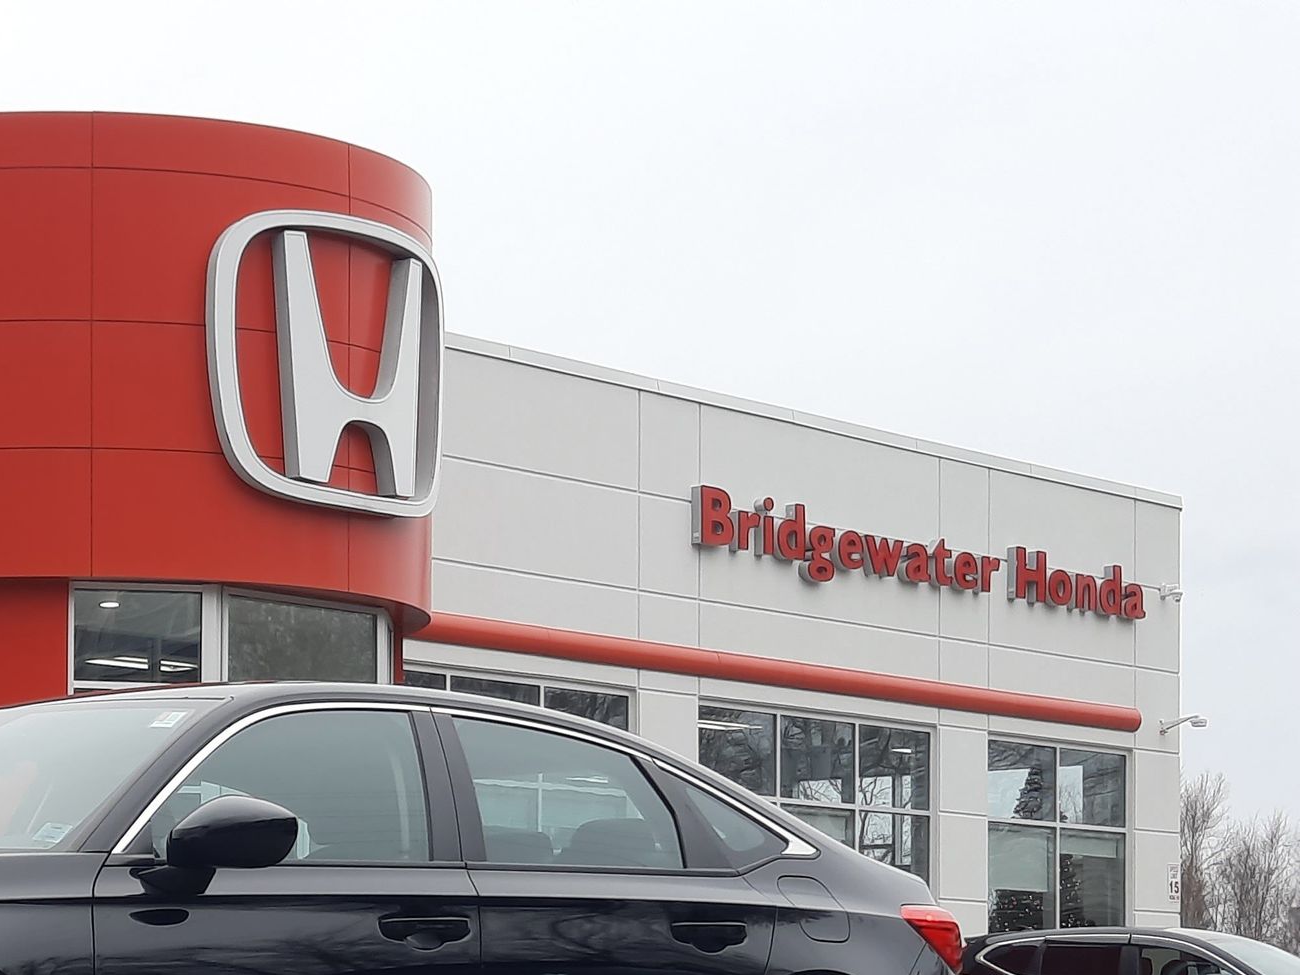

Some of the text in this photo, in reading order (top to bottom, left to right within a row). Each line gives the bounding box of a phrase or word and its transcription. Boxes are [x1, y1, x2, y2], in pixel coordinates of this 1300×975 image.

[692, 484, 1146, 620] Bridgewater Honda
[1169, 880, 1180, 894] 15
